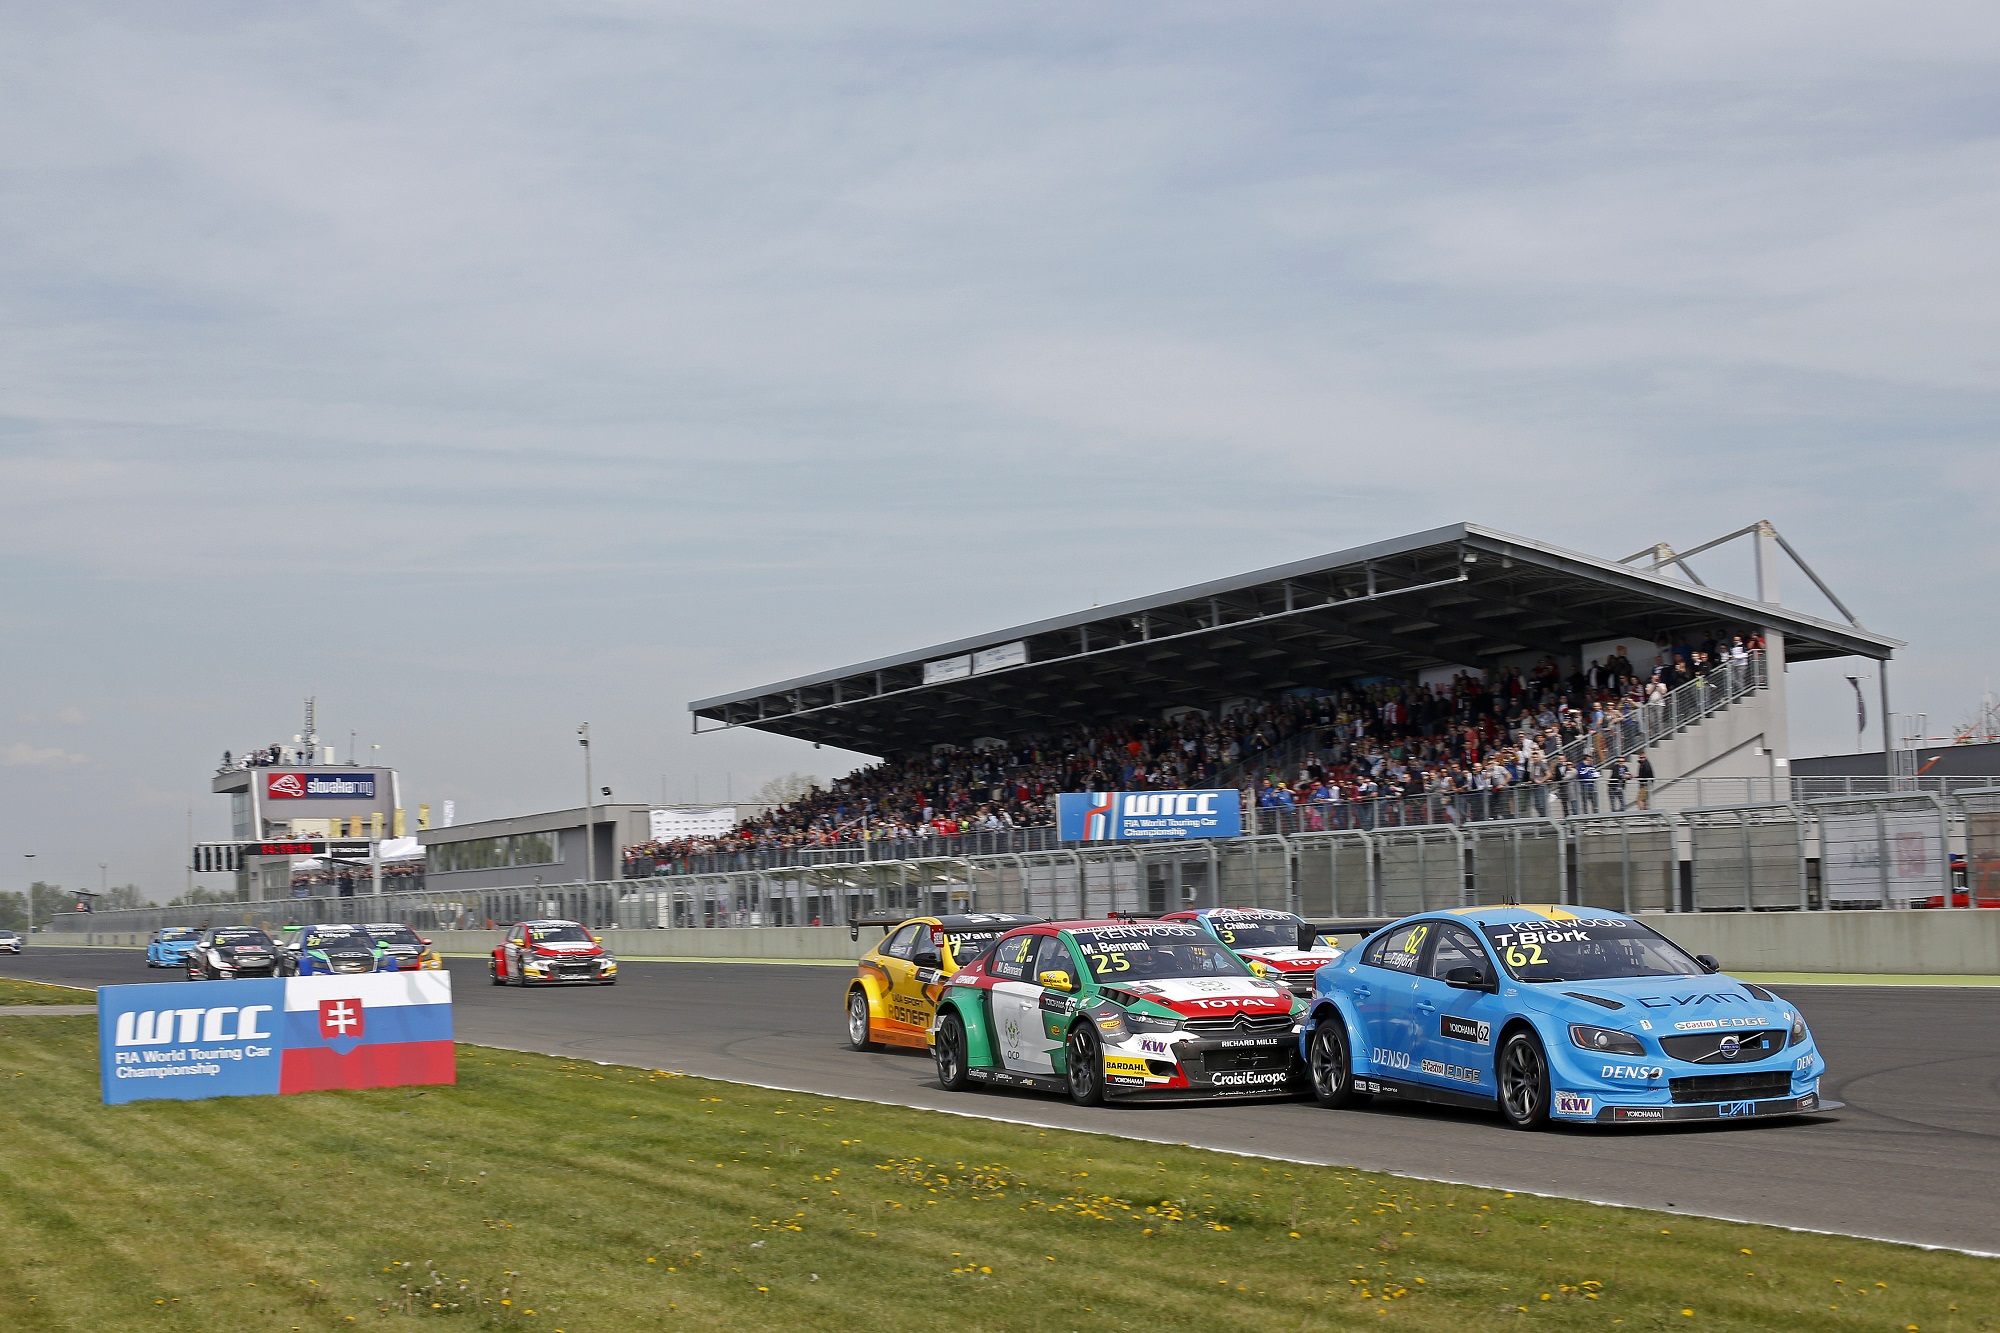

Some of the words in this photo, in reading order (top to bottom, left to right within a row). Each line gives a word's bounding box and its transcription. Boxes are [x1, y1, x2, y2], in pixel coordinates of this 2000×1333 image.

[1123, 793, 1219, 816] WTCC
[1123, 819, 1140, 828] FIA
[1140, 818, 1167, 827] World
[1167, 818, 1200, 828] Touring
[1200, 817, 1219, 826] Car
[1123, 828, 1187, 837] Championship
[1212, 923, 1222, 931] T.
[1223, 922, 1260, 931] Chilton
[1508, 918, 1627, 933] KENWOOD
[1093, 927, 1197, 941] KENWOOD
[1222, 930, 1236, 944] 3
[1404, 925, 1428, 954] 62
[949, 940, 961, 956] 7
[1080, 944, 1098, 955] M.
[1098, 940, 1151, 953] Bennani
[1505, 943, 1549, 967] 62
[1091, 952, 1131, 974] 25
[1286, 959, 1330, 967] TOTA
[1191, 999, 1276, 1009] TOTAL
[1636, 993, 1749, 1008] CYAN
[115, 1004, 273, 1047] WTCC
[1685, 1020, 1715, 1029] Castrol
[1719, 1017, 1770, 1028] EDGE
[1478, 1025, 1489, 1041] 62
[1141, 1039, 1168, 1053] KW
[1221, 1039, 1254, 1047] RICHARD
[1256, 1038, 1278, 1046] MILLE
[115, 1051, 141, 1064] FIA
[142, 1049, 186, 1063] World
[188, 1047, 242, 1061] Touring
[244, 1045, 272, 1057] Car
[1373, 1047, 1410, 1069] DENSO
[1796, 1053, 1815, 1071] DENS
[115, 1062, 221, 1079] Championship
[1106, 1061, 1146, 1072] BARDAHL
[1445, 1064, 1480, 1084] EDGE
[1601, 1065, 1663, 1080] DENSO
[1114, 1076, 1143, 1085] YOKOHAMA
[1211, 1071, 1287, 1086] CroisiEurope
[1561, 1098, 1590, 1111] KW
[1718, 1101, 1756, 1116] CYAN
